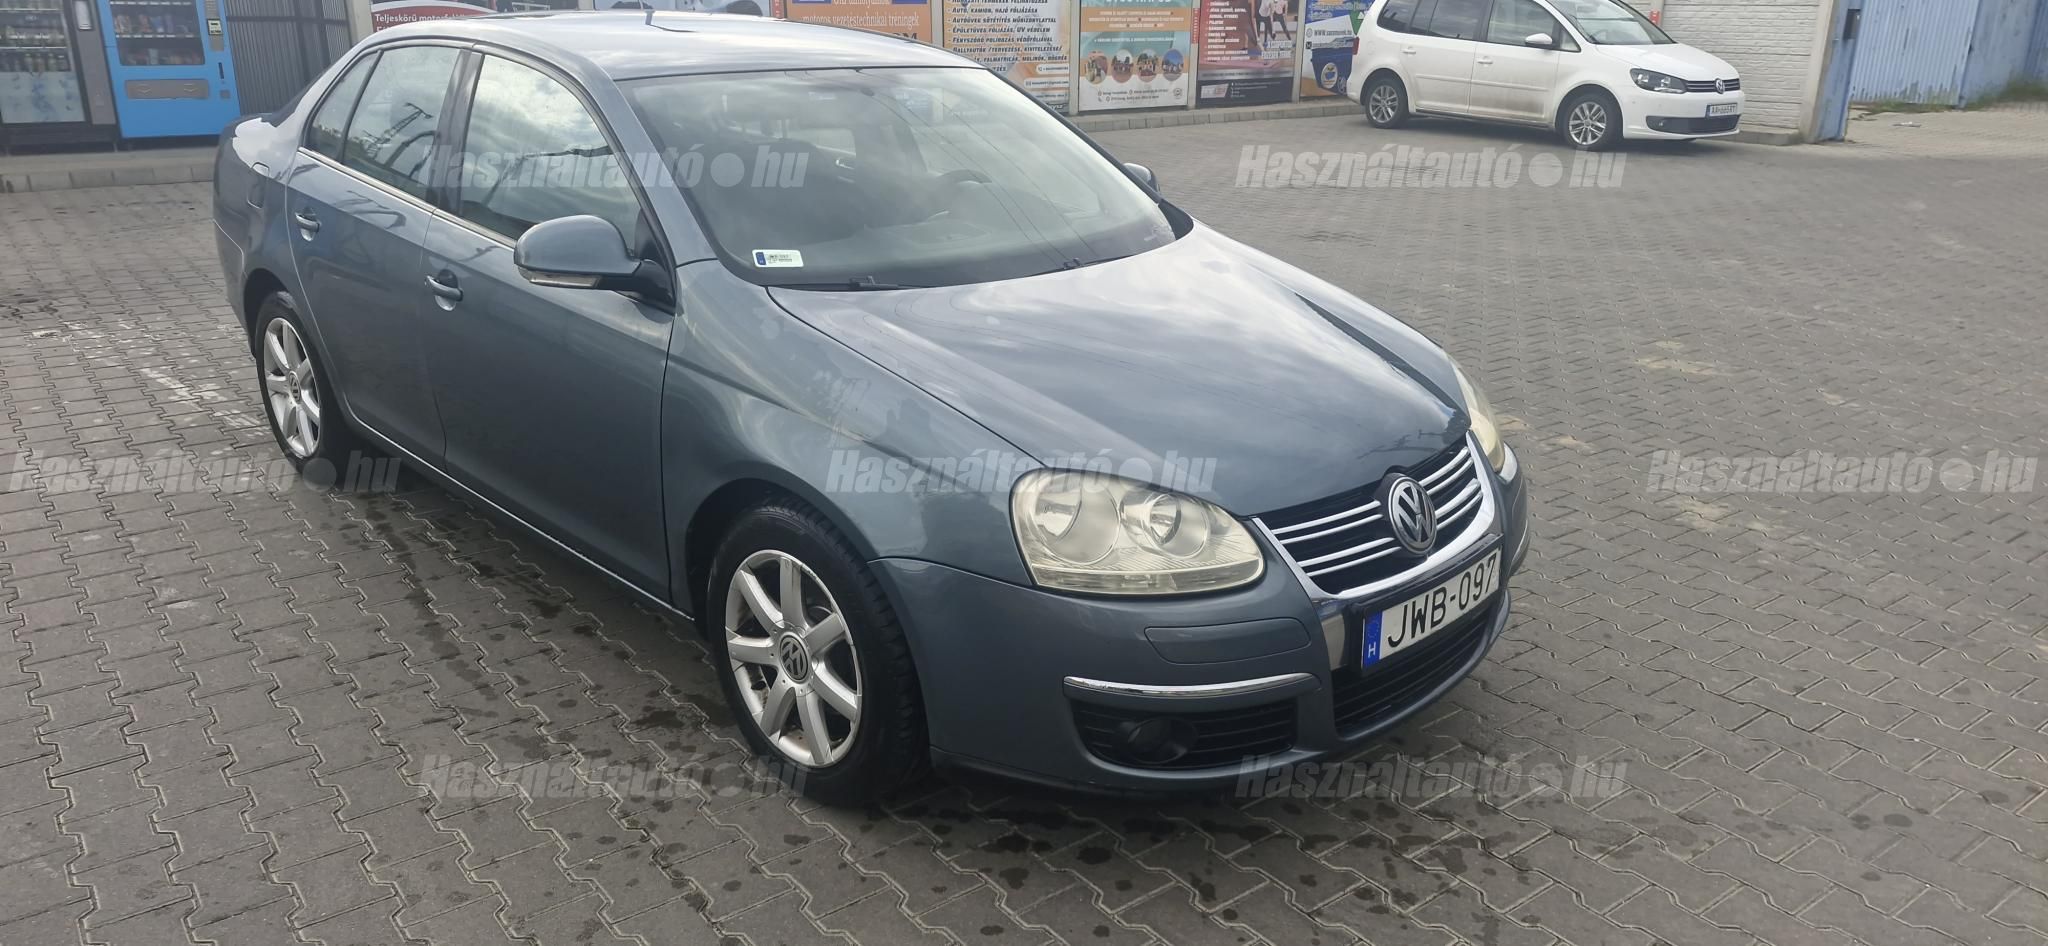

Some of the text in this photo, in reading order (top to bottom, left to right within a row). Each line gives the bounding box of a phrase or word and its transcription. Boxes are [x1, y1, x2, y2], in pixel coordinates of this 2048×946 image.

[888, 11, 920, 30] tréningek
[1387, 552, 1497, 648] JWB-097
[1367, 641, 1377, 658] H
